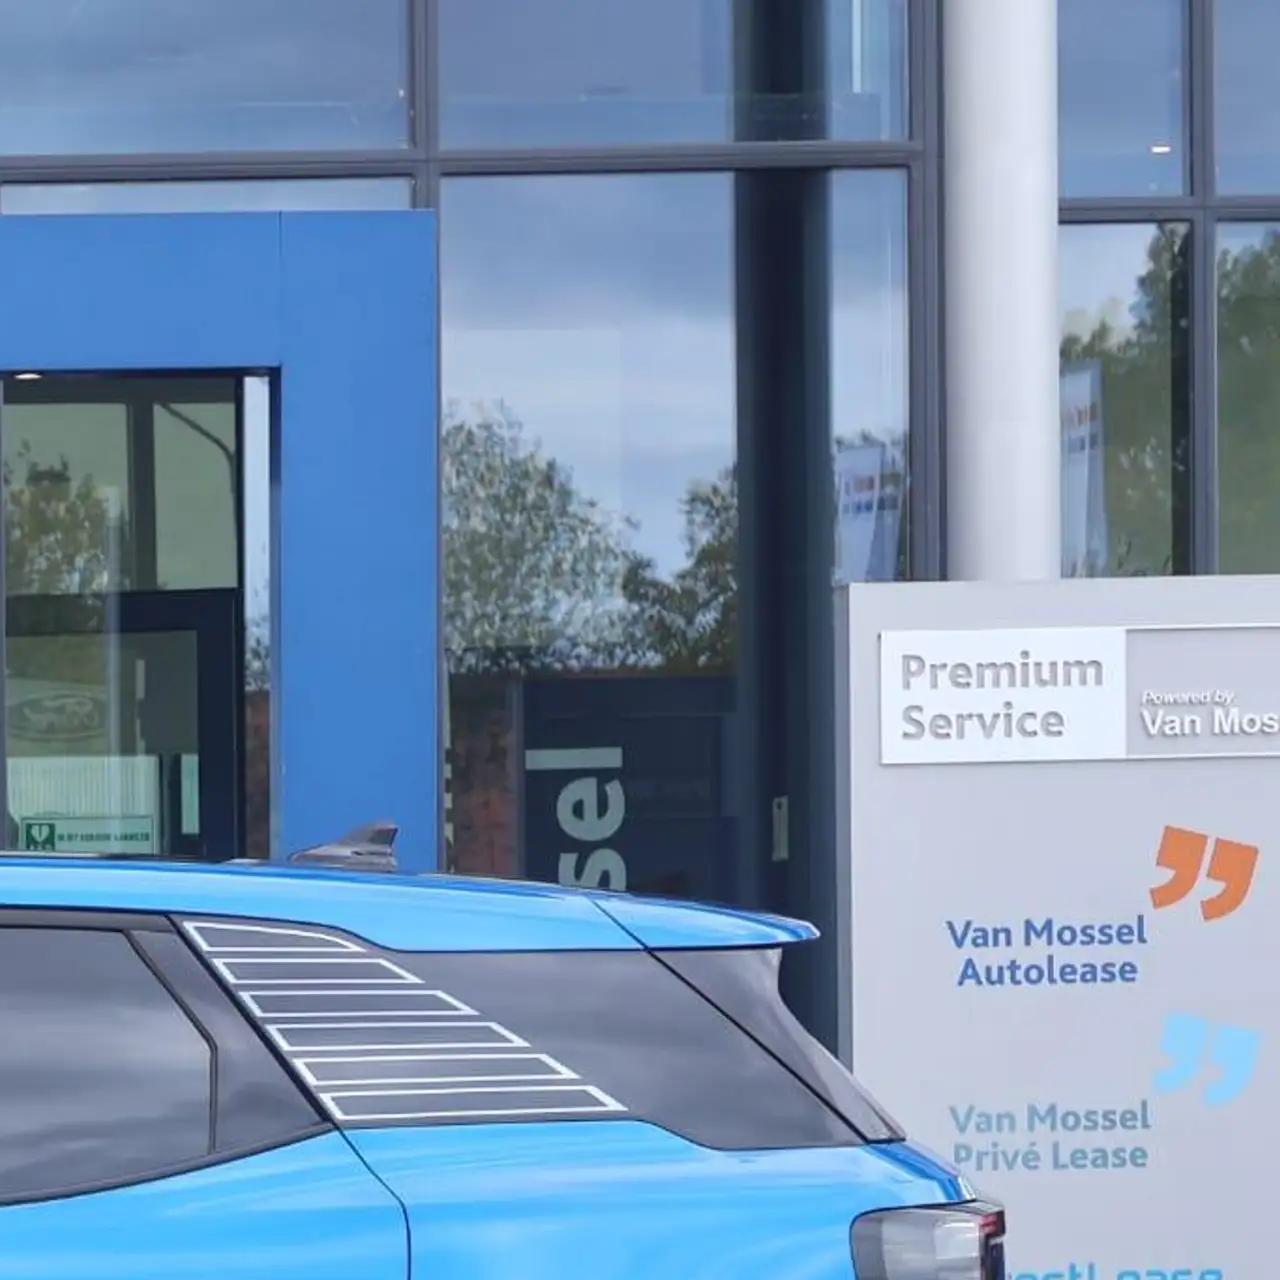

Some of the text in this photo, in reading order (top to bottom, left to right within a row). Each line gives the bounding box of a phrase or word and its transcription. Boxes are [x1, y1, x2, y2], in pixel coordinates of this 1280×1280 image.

[901, 649, 1104, 691] Premium
[1214, 689, 1234, 705] by
[901, 701, 1067, 740] Service
[1140, 707, 1201, 736] Van
[946, 914, 1148, 949] Van Mossel
[957, 953, 1139, 987] Autolease
[949, 1100, 1152, 1134] Van Mossel
[954, 1141, 1148, 1171] Privé Lease
